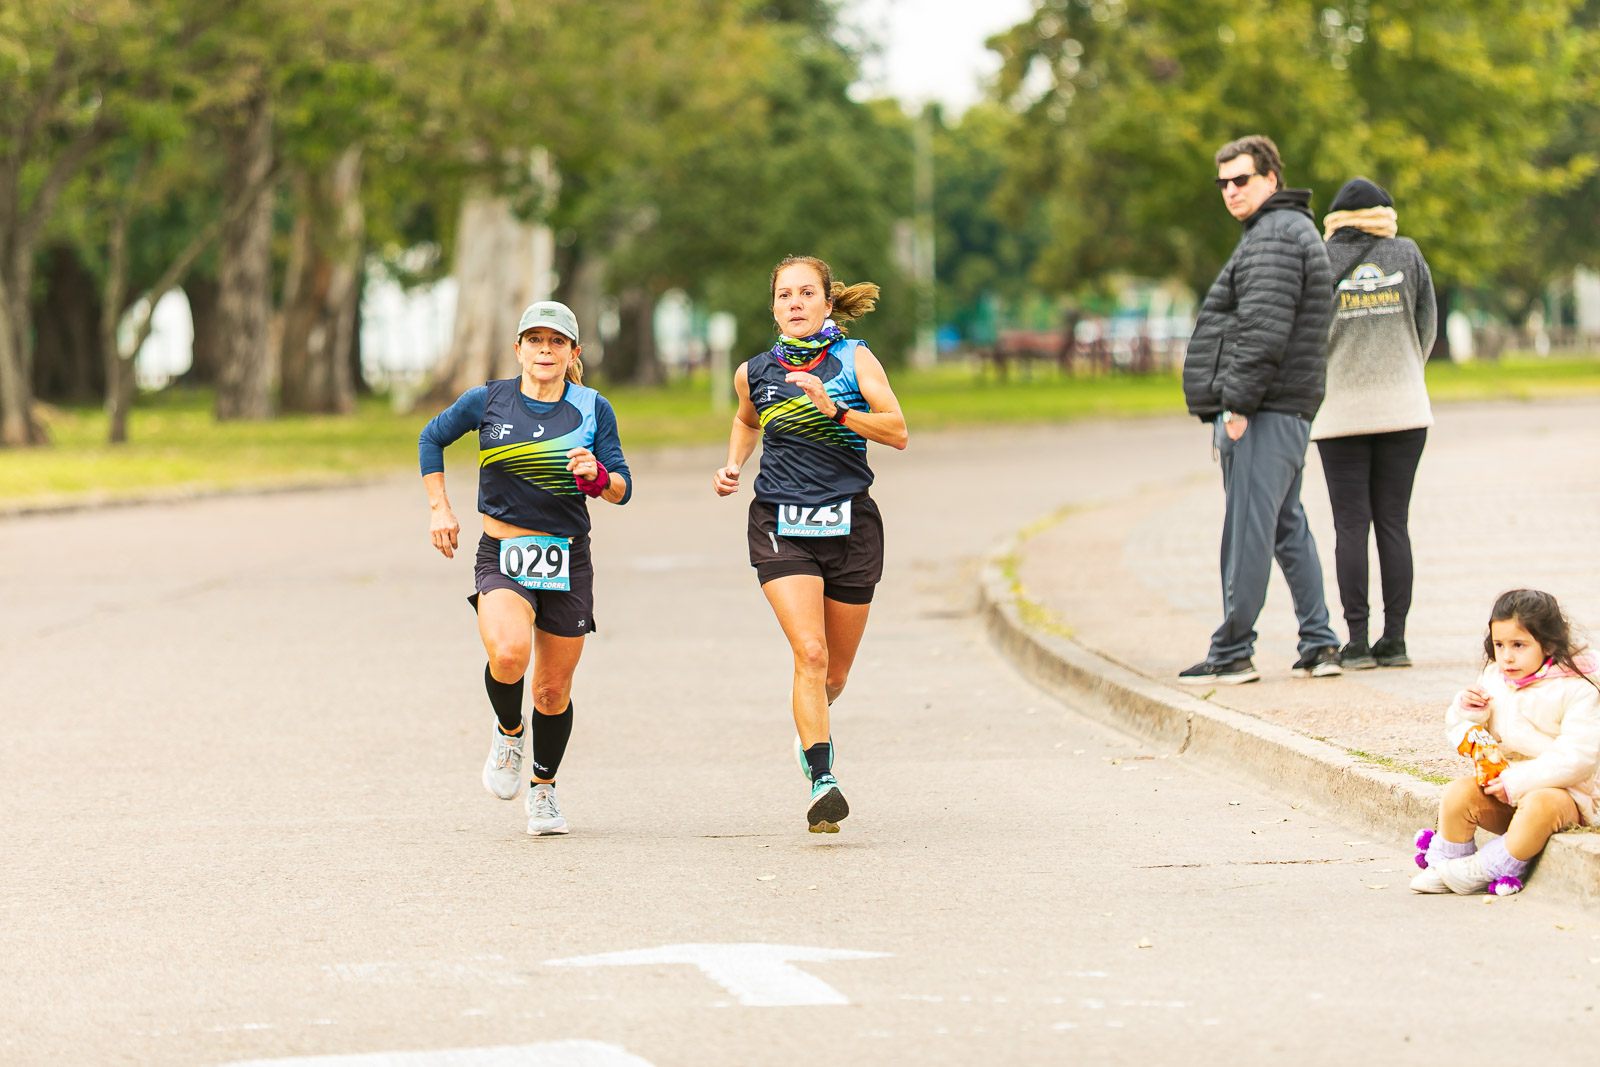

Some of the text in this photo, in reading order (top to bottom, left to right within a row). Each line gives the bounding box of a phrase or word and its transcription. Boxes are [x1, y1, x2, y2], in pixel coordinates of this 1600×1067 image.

[759, 386, 778, 402] SF
[490, 424, 513, 439] SF
[505, 545, 562, 578] 029
